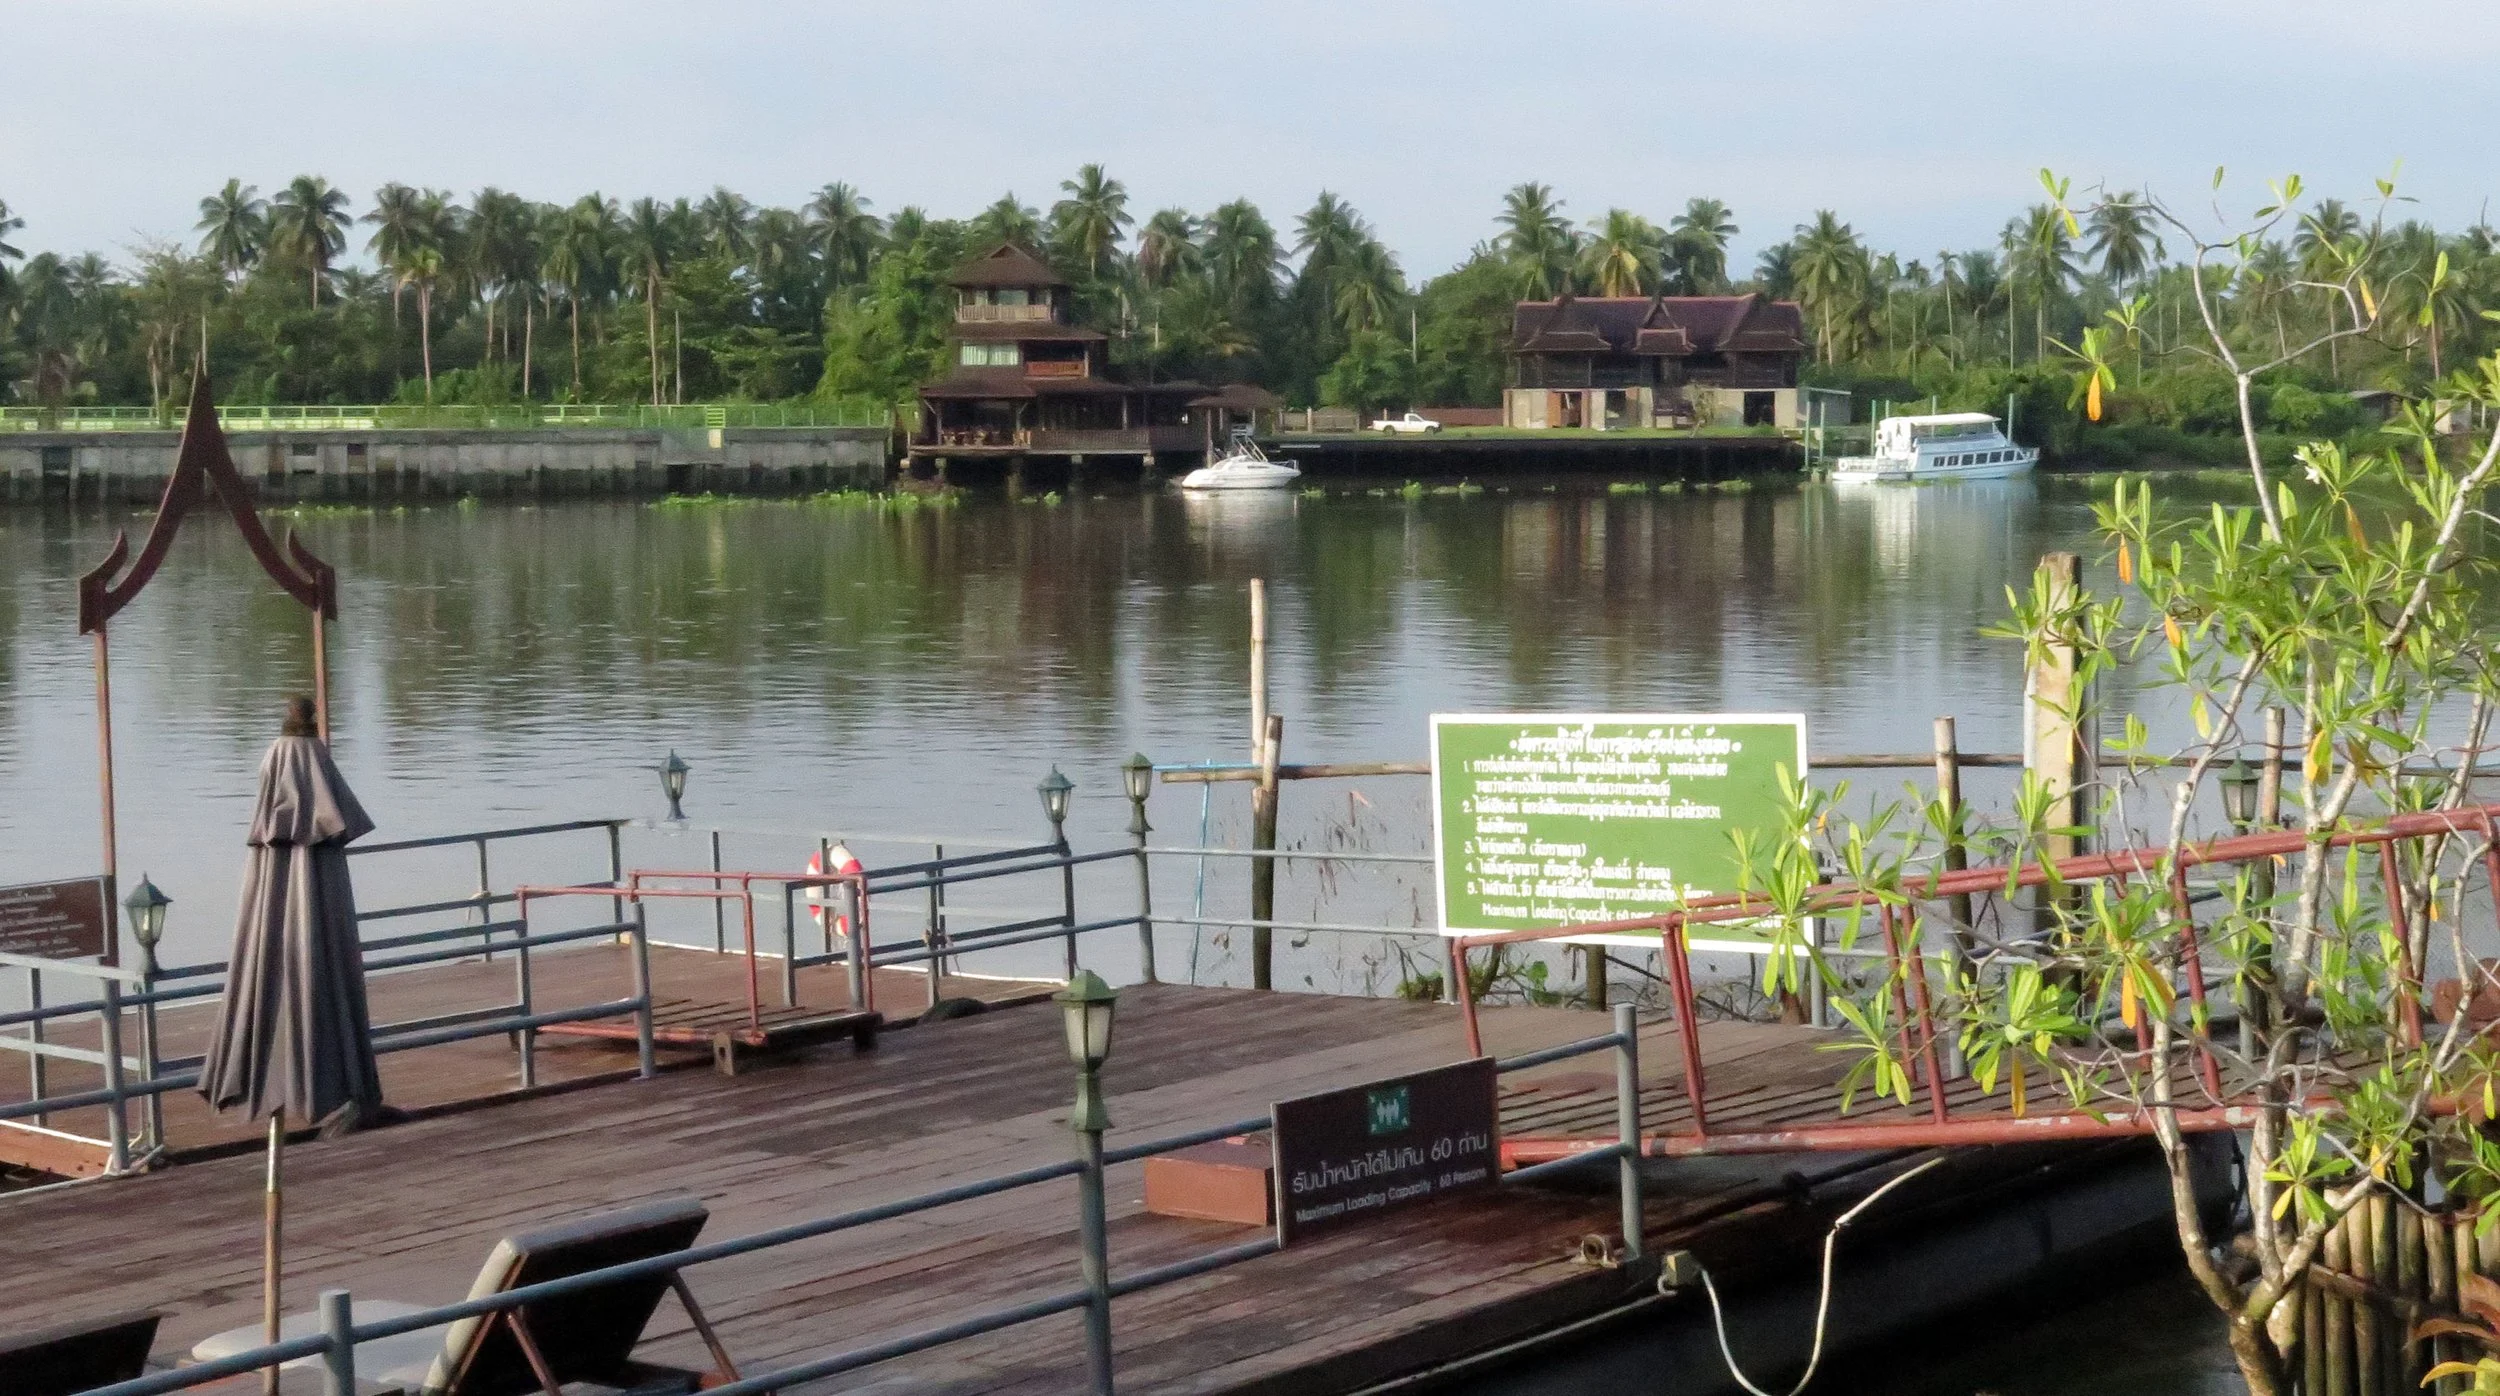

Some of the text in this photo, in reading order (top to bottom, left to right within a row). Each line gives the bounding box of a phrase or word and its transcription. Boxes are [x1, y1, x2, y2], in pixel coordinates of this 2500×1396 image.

[1462, 800, 1473, 813] 2.
[1465, 861, 1476, 873] 4.
[1467, 881, 1479, 895] 5.
[1482, 902, 1528, 918] Maximum
[1531, 899, 1568, 927] Loading
[1431, 1137, 1452, 1161] 60
[1459, 1132, 1488, 1154] ท่าน
[1295, 1201, 1345, 1223] Maximum
[1347, 1192, 1386, 1208] Loading
